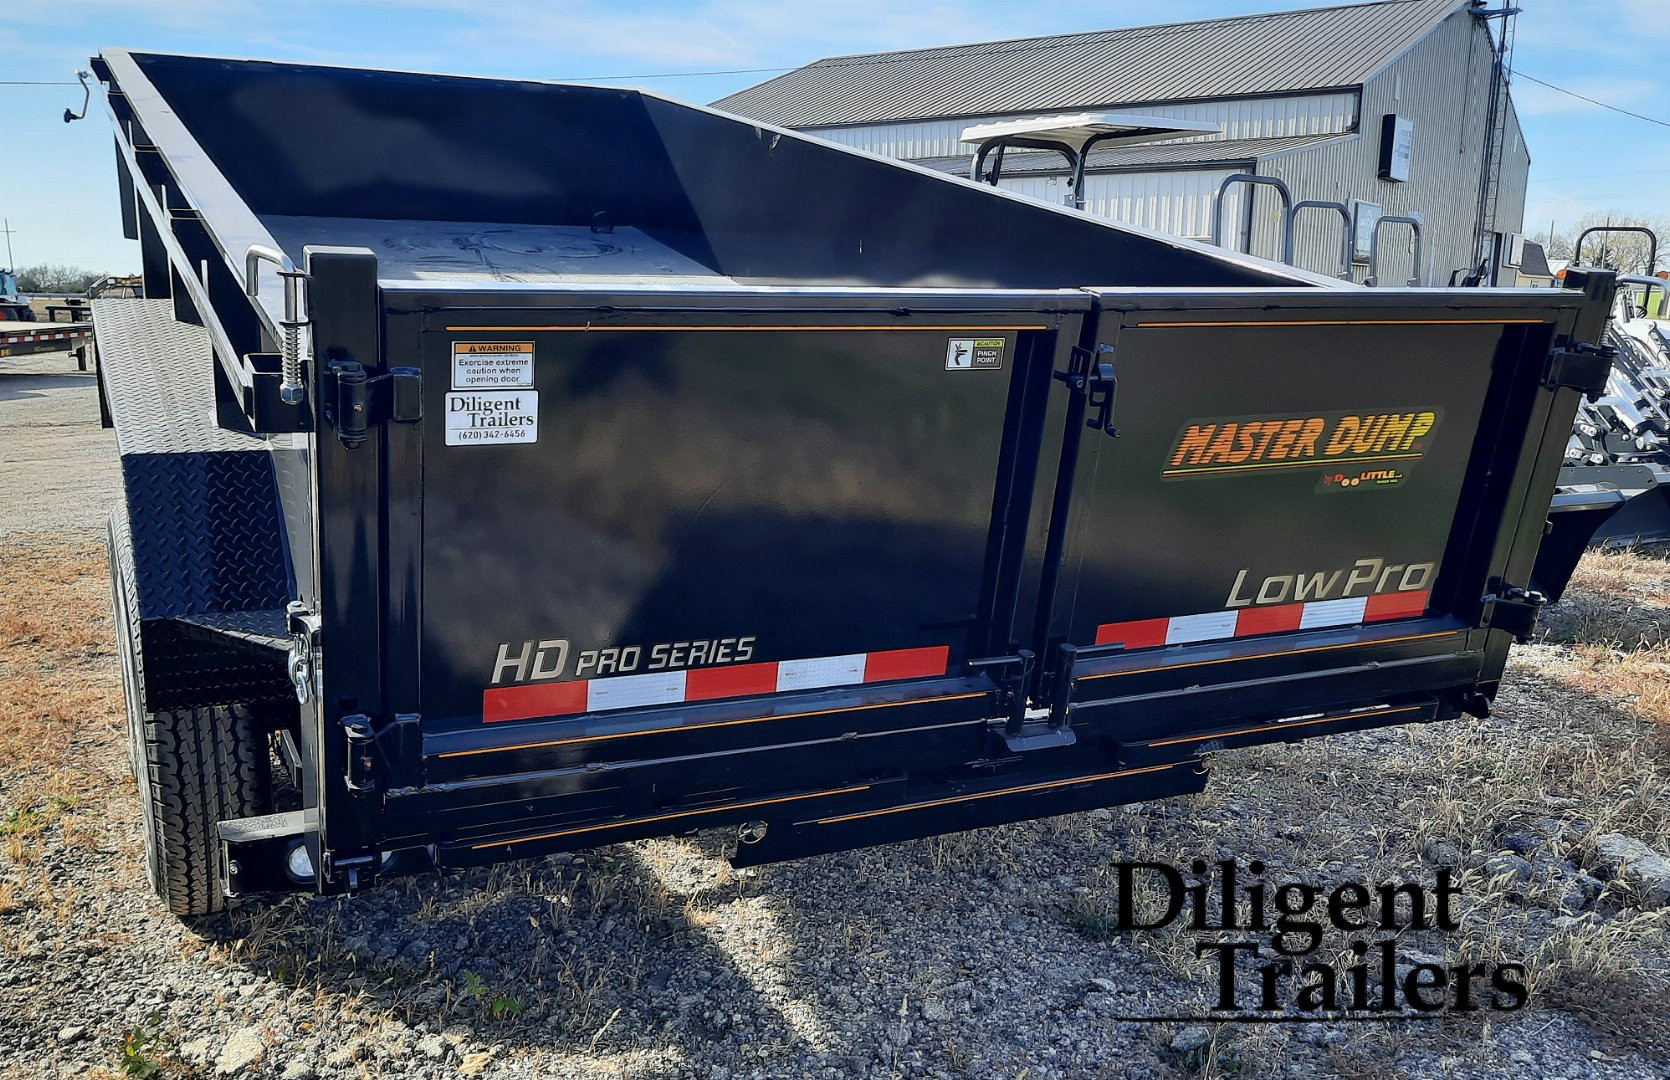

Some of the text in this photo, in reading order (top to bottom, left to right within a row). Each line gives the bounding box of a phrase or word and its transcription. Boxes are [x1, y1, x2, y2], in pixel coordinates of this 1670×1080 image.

[450, 396, 521, 416] Diligent
[467, 412, 534, 428] Trailers
[458, 429, 526, 441] (620) 342-6456
[1169, 411, 1435, 466] MASTER DUMP
[491, 636, 756, 684] HD PRO SERIES
